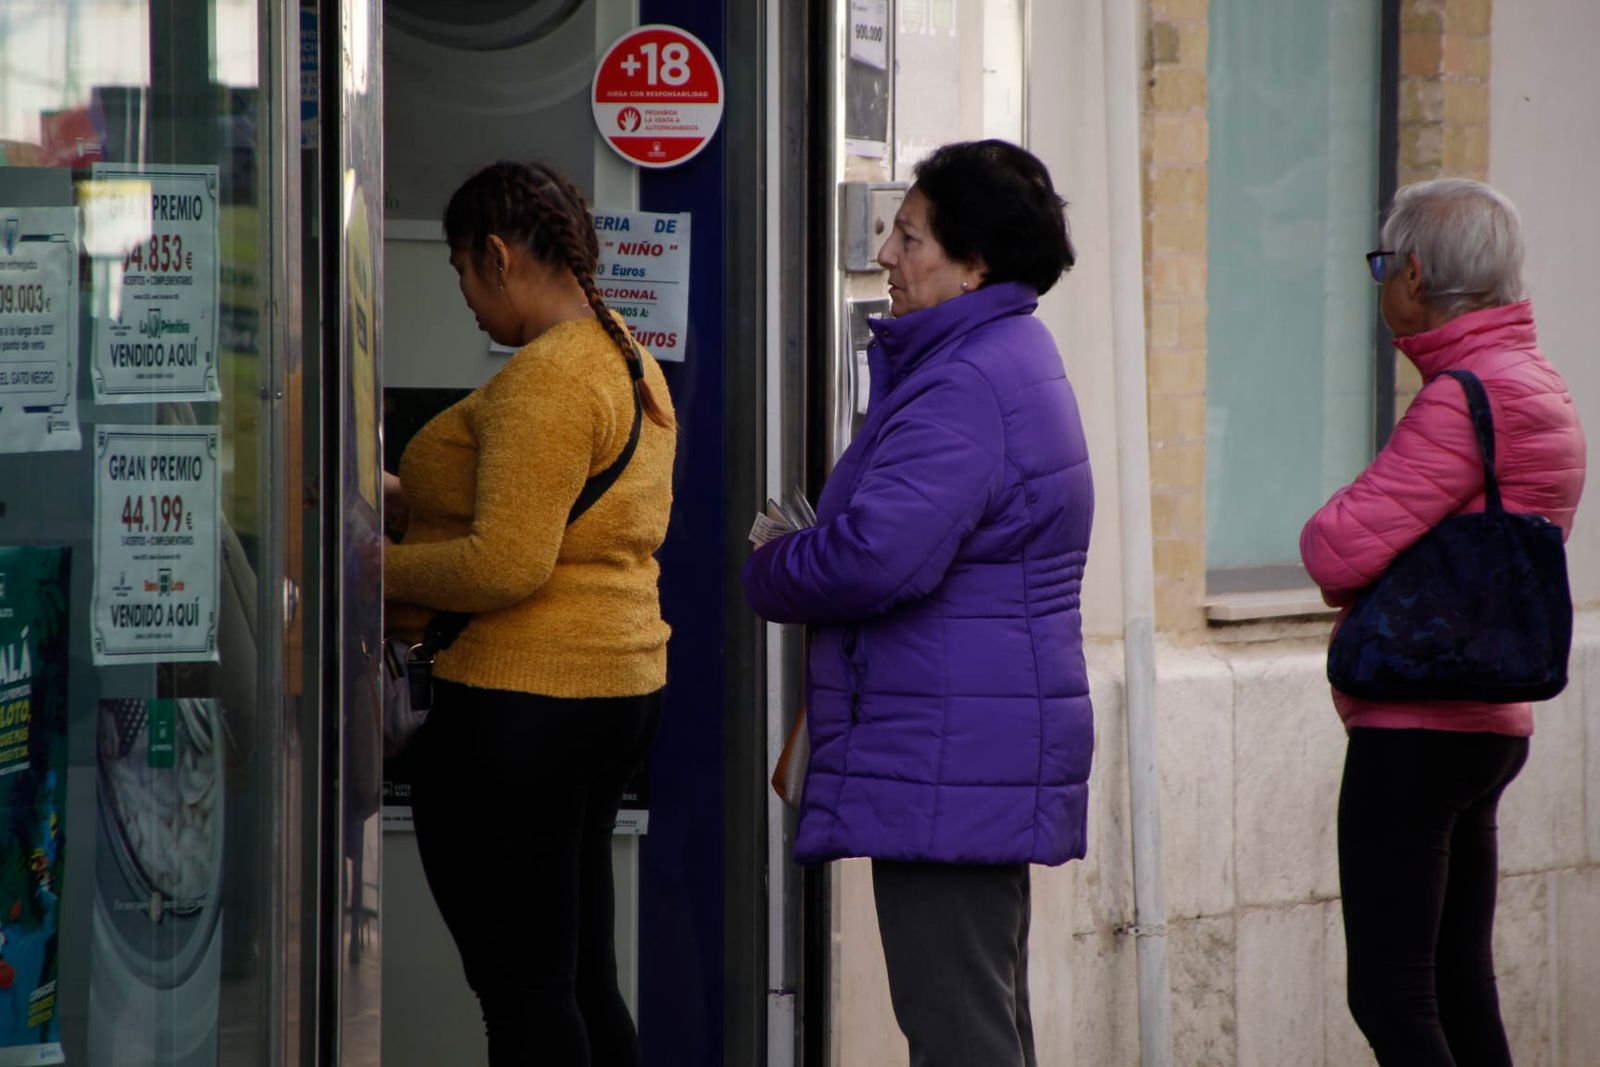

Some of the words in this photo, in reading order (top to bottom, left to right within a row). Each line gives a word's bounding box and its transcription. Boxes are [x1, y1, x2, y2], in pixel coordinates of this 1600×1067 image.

[855, 23, 883, 42] 900.000
[620, 42, 691, 86] +18
[152, 195, 203, 221] PREMIO
[654, 218, 677, 234] DE
[617, 240, 664, 257] NIÑO
[612, 264, 646, 277] Euros
[110, 343, 164, 368] VENDIDO
[167, 336, 199, 368] AQUÍ
[109, 454, 146, 482] GRAN
[151, 454, 202, 482] PREMIO
[110, 603, 164, 628] VENDIDO
[167, 596, 200, 627] AQUÍ
